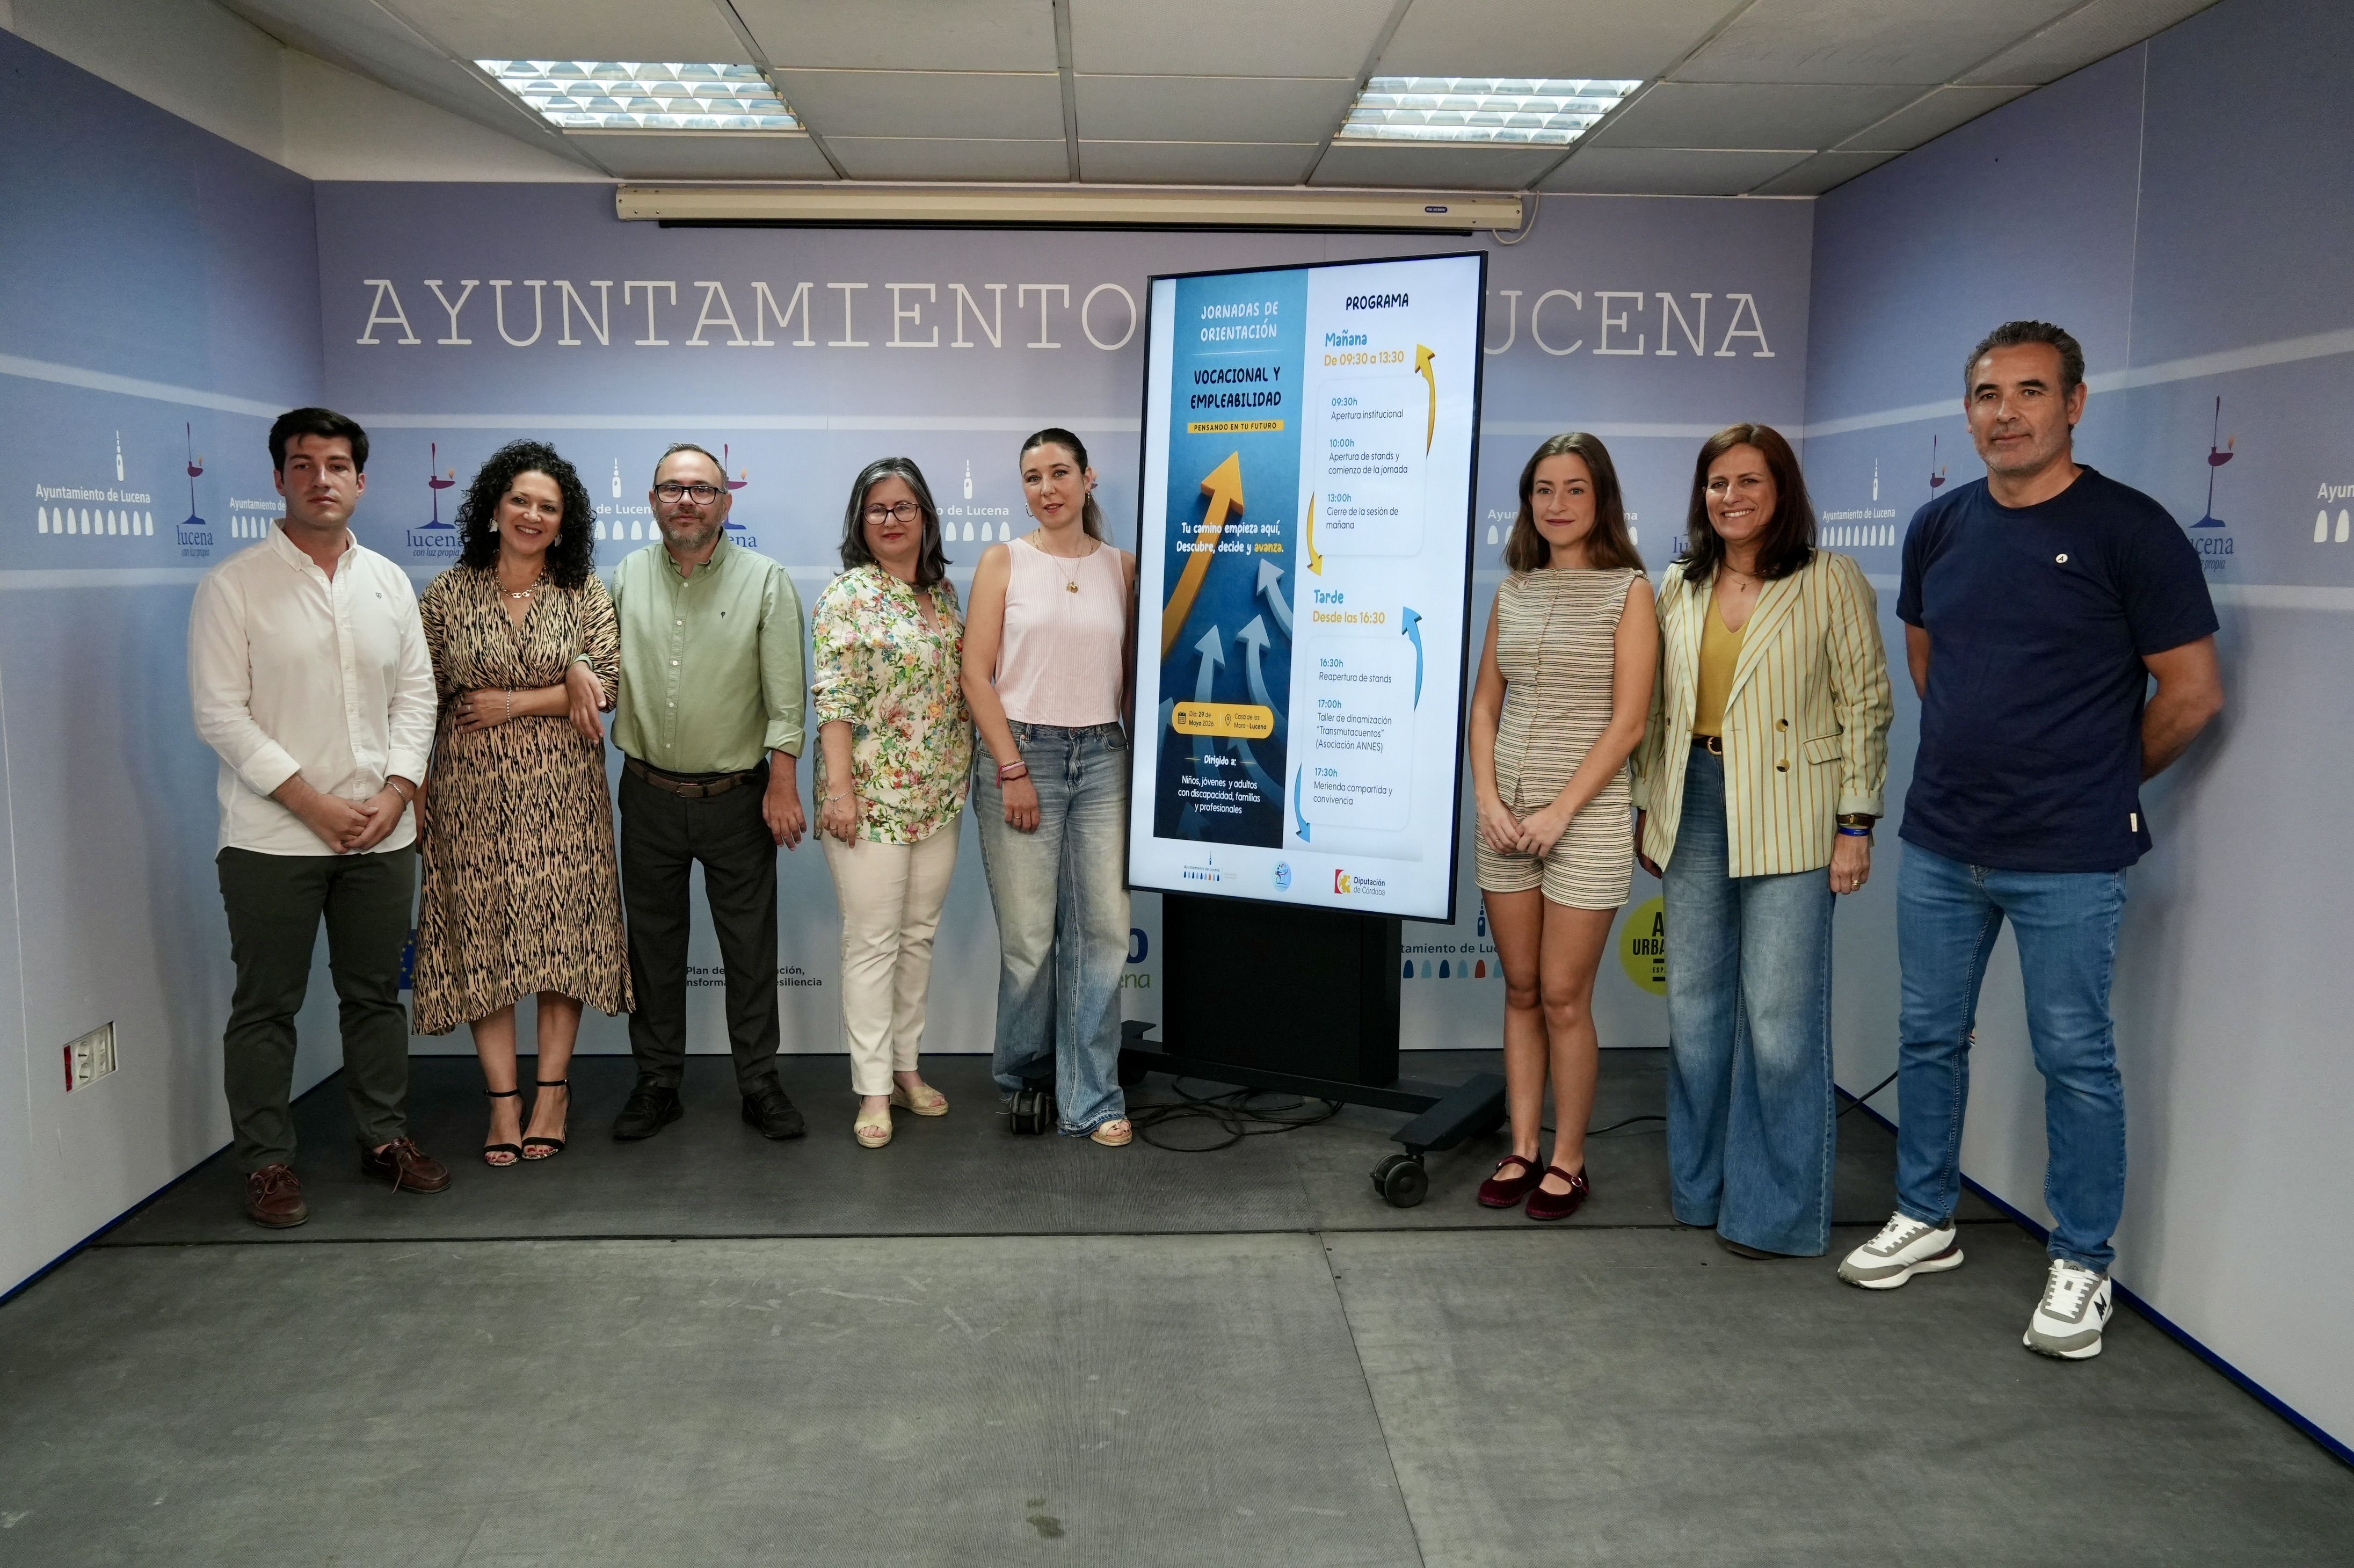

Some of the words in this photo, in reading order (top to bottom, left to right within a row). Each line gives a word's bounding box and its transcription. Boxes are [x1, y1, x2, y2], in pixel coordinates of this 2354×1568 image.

[1346, 293, 1408, 310] PROGRAMA
[1201, 302, 1259, 320] JORNADAS
[1265, 301, 1278, 315] DE
[356, 279, 1137, 351] AYUNTAMIENTO
[1484, 289, 1775, 357] UCENA
[1201, 318, 1277, 342] ORIENTACIÓN
[1325, 329, 1367, 347] Mañana
[1324, 354, 1337, 366] De
[1340, 353, 1368, 365] 09:30
[1370, 355, 1376, 364] a
[1379, 351, 1404, 363] 13:30
[1194, 367, 1268, 384] VOCACIONAL
[1274, 366, 1280, 381] Y
[1191, 391, 1281, 409] EMPLEABILIDAD
[1332, 397, 1357, 406] 09:30h
[1331, 411, 1361, 422] Apertura
[1363, 409, 1404, 418] institucional
[1329, 439, 1354, 447] 10:00h
[1329, 453, 1359, 463] Apertura
[1361, 452, 1369, 460] de
[1371, 451, 1394, 460] stands
[1396, 453, 1400, 462] y
[1328, 466, 1361, 474] comienzo
[1363, 465, 1371, 474] de
[1373, 465, 1379, 474] la
[1381, 464, 1408, 476] jornada
[35, 483, 105, 502] Ayuntamiento
[107, 488, 118, 502] de
[121, 489, 150, 503] Lucena
[1328, 493, 1351, 502] 13:00h
[230, 497, 277, 511] Ayuntamiento
[278, 499, 286, 511] de
[596, 504, 612, 514] de
[616, 504, 653, 514] Lucen
[947, 505, 962, 516] de
[967, 505, 1009, 516] Lucena
[1327, 507, 1347, 516] Cierre
[1349, 507, 1357, 516] de
[1359, 507, 1365, 516] la
[1367, 507, 1387, 516] sesión
[1390, 507, 1399, 516] de
[1822, 509, 1863, 523] Ayuntamiento
[1864, 507, 1871, 519] de
[1873, 508, 1895, 518] Lucena
[1181, 522, 1191, 534] Tu
[1193, 522, 1222, 534] camino
[1224, 522, 1258, 537] empieza
[1261, 519, 1280, 537] aquí,
[1326, 520, 1354, 529] mañana
[176, 525, 213, 546] lucena
[426, 548, 437, 556] luz
[437, 548, 460, 558] propia
[1176, 540, 1215, 554] Descubre,
[1218, 541, 1244, 552] decide
[1246, 543, 1252, 556] y
[1254, 542, 1284, 553] avanza.
[1314, 589, 1344, 604] Tarde
[1313, 611, 1342, 622] Desde
[1345, 612, 1357, 623] las
[1360, 612, 1385, 624] 16:30
[1320, 658, 1343, 667] 16:30h
[1319, 672, 1357, 683] Reapertura
[1359, 673, 1368, 682] de
[1369, 674, 1392, 683] stands
[1318, 699, 1341, 708] 17:00h
[1318, 713, 1335, 722] Taller
[1336, 714, 1345, 722] de
[1347, 714, 1392, 724] dinamización
[1316, 738, 1355, 750] (Asociación
[1356, 742, 1383, 753] ANNES)
[1204, 754, 1229, 767] Dirigido
[1315, 767, 1338, 777] 17:30h
[1182, 775, 1201, 786] Niños,
[1201, 776, 1226, 787] jóvenes
[1228, 780, 1233, 789] y
[1234, 779, 1258, 789] adultos
[1178, 789, 1190, 797] con
[1190, 789, 1234, 802] discapacidad,
[1236, 792, 1261, 802] familias
[1314, 781, 1346, 791] Merienda
[1347, 785, 1387, 794] compartida
[1389, 788, 1393, 797] y
[1313, 795, 1353, 805] convivencia
[1194, 803, 1199, 812] y
[1200, 802, 1243, 814] profesionales
[1354, 876, 1385, 886] Diputación
[1362, 886, 1385, 896] Córdoba
[1401, 943, 1456, 953] tamiento
[1460, 943, 1474, 953] de
[687, 967, 708, 975] Plan
[712, 966, 725, 975] de
